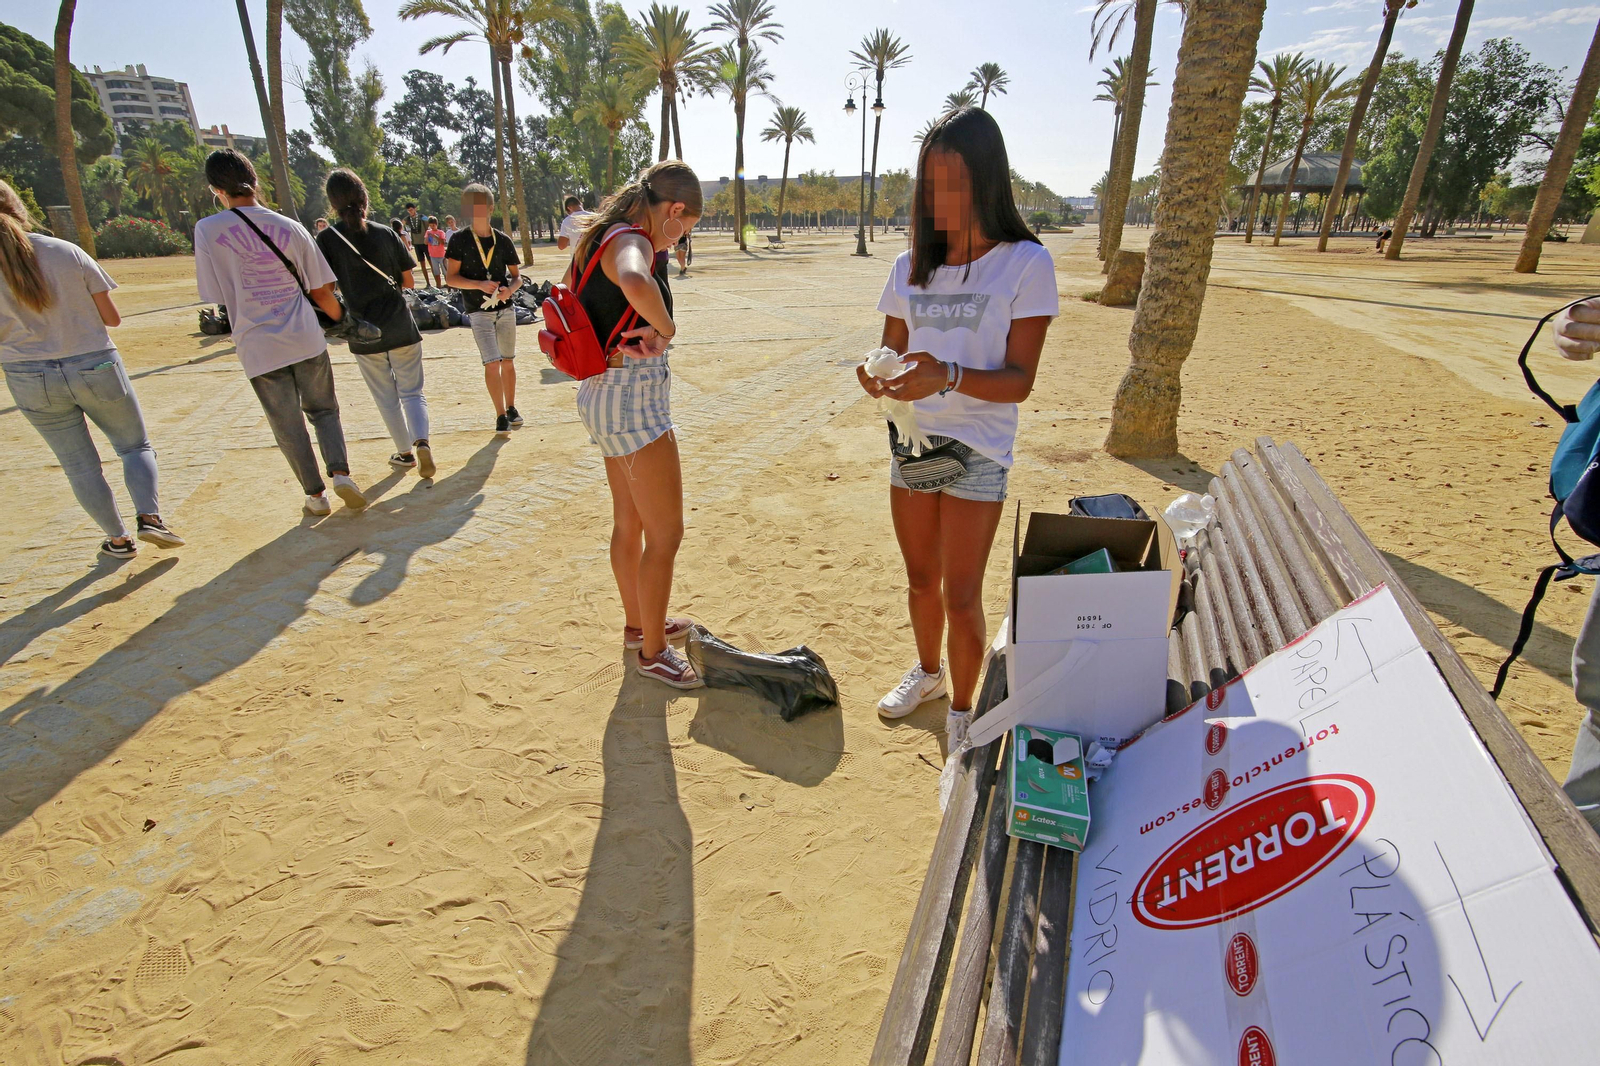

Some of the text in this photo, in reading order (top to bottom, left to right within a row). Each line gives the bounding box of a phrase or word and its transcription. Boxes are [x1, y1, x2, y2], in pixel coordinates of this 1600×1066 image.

[1063, 766, 1076, 778] M
[1018, 811, 1028, 819] M
[1031, 814, 1057, 826] Latex
[1156, 796, 1347, 910] TORRENT
[1083, 845, 1122, 1005] VIDRIO
[1234, 940, 1250, 990] TORRENT
